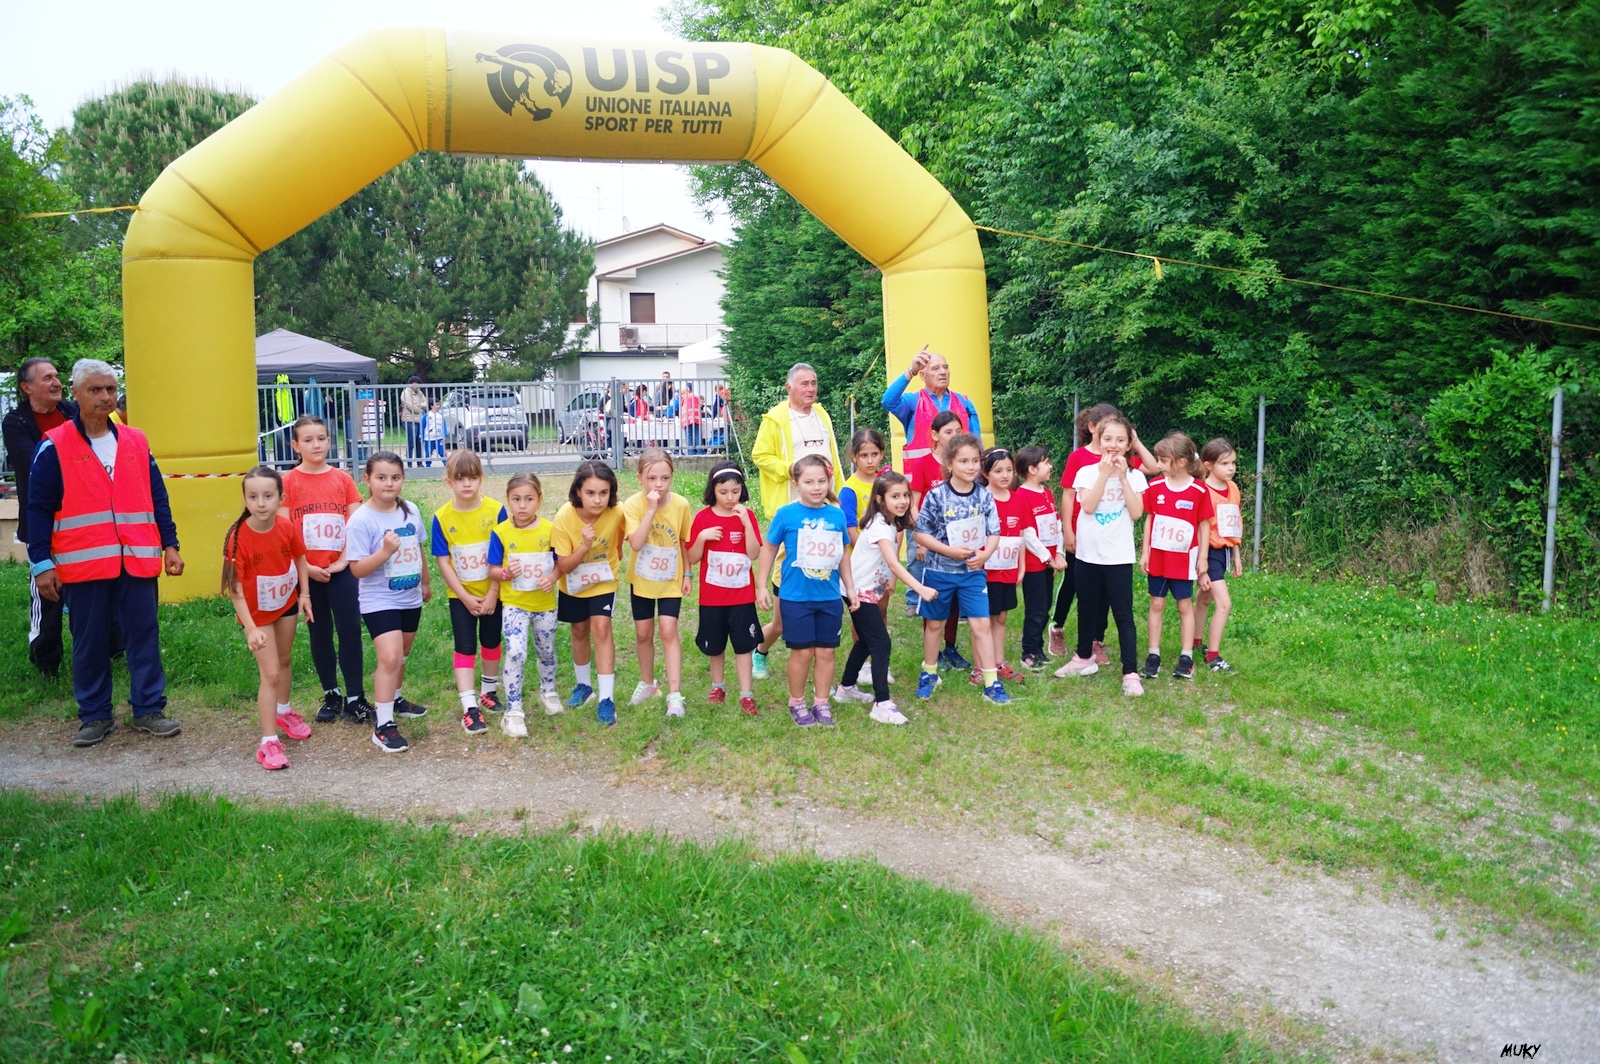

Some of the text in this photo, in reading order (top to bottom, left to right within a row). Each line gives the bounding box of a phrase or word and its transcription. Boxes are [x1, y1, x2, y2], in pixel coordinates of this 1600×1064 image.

[582, 47, 731, 96] UISP
[585, 96, 732, 117] UNIONE ITALIANA
[584, 116, 723, 135] SPORT PER TUTTI
[313, 523, 342, 539] 102
[962, 527, 979, 544] 92
[1159, 525, 1185, 543] 116
[393, 546, 418, 564] 253
[806, 541, 836, 558] 292
[459, 552, 489, 570] 334
[650, 556, 669, 572] 58
[716, 562, 744, 577] 107
[523, 564, 543, 579] 55
[580, 573, 601, 587] 59
[268, 576, 294, 600] 108
